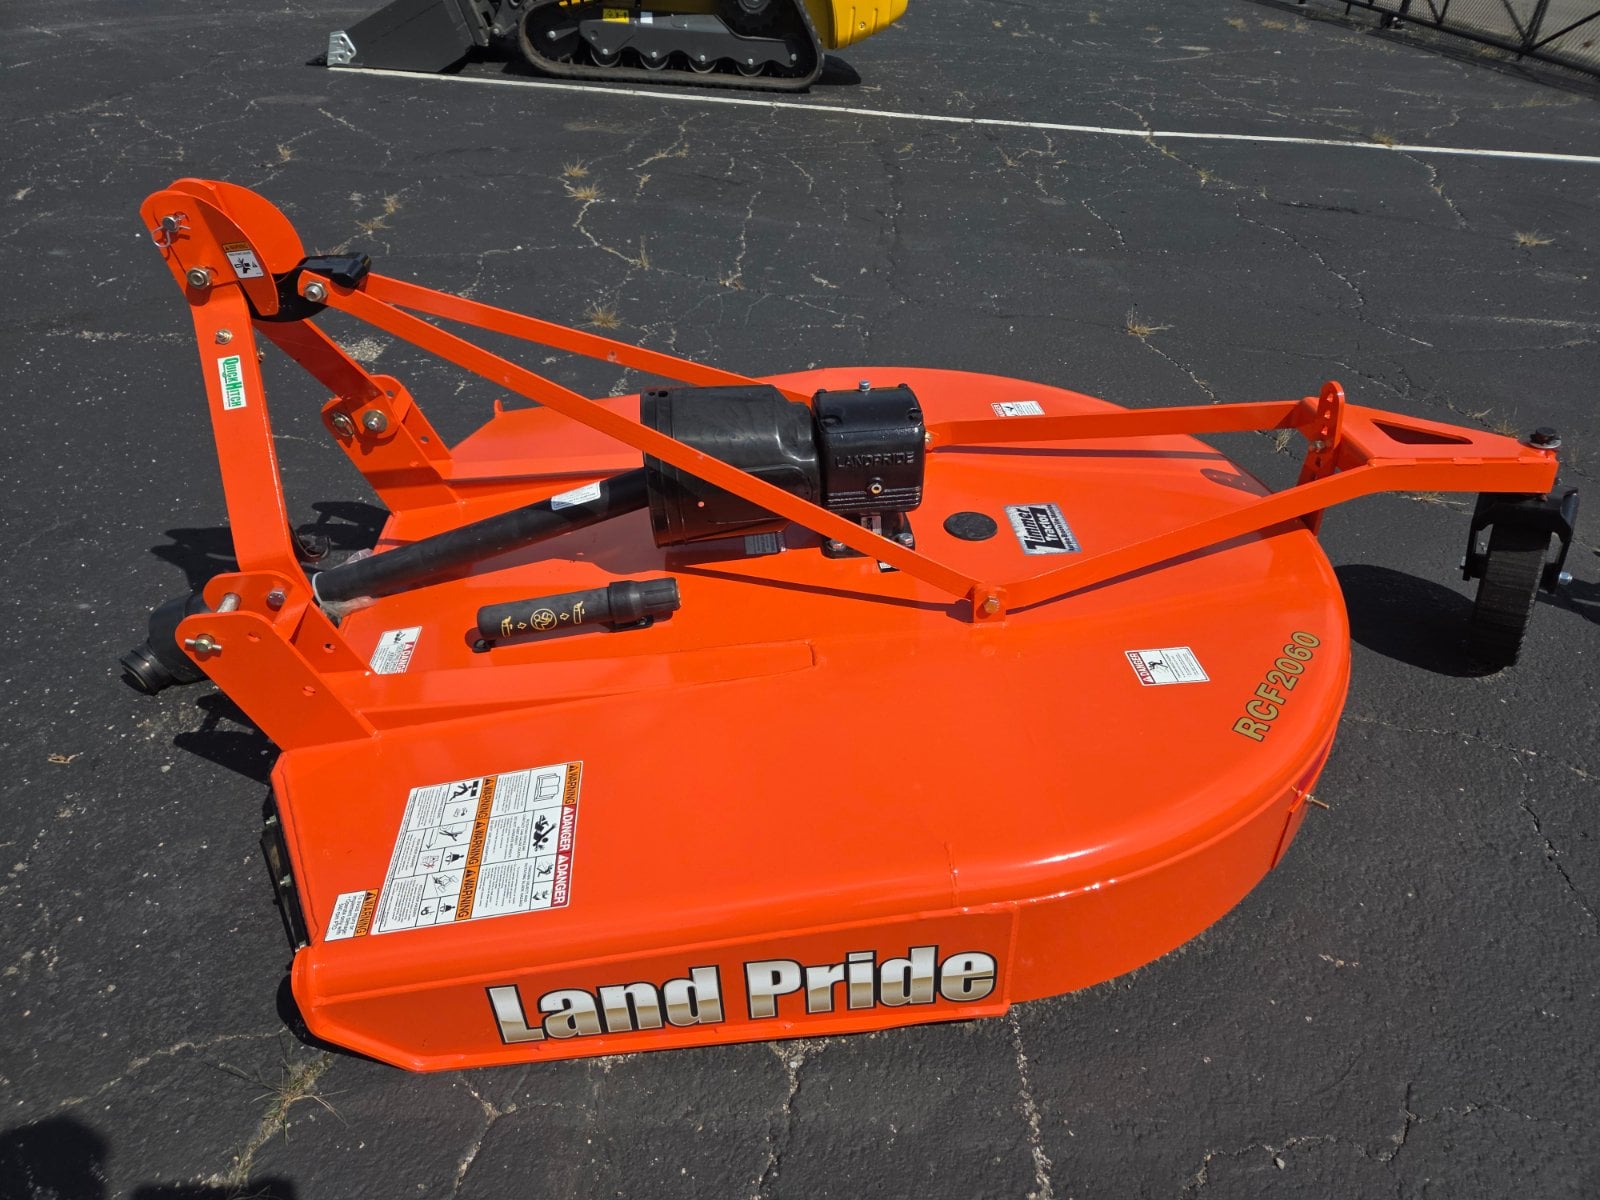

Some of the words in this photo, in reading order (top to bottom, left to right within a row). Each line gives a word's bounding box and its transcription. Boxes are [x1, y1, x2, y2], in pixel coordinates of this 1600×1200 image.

[1016, 508, 1056, 549] Zimmer
[1037, 513, 1060, 541] Tractor
[1232, 631, 1320, 742] RCF2060
[477, 785, 493, 818] WARNING
[565, 769, 578, 804] WARNING
[468, 828, 484, 865] WARNING
[559, 814, 573, 852] DANGER
[457, 877, 475, 918] WARNING
[554, 863, 568, 904] DANGER
[486, 966, 725, 1045] Land
[744, 945, 998, 1021] Pride
